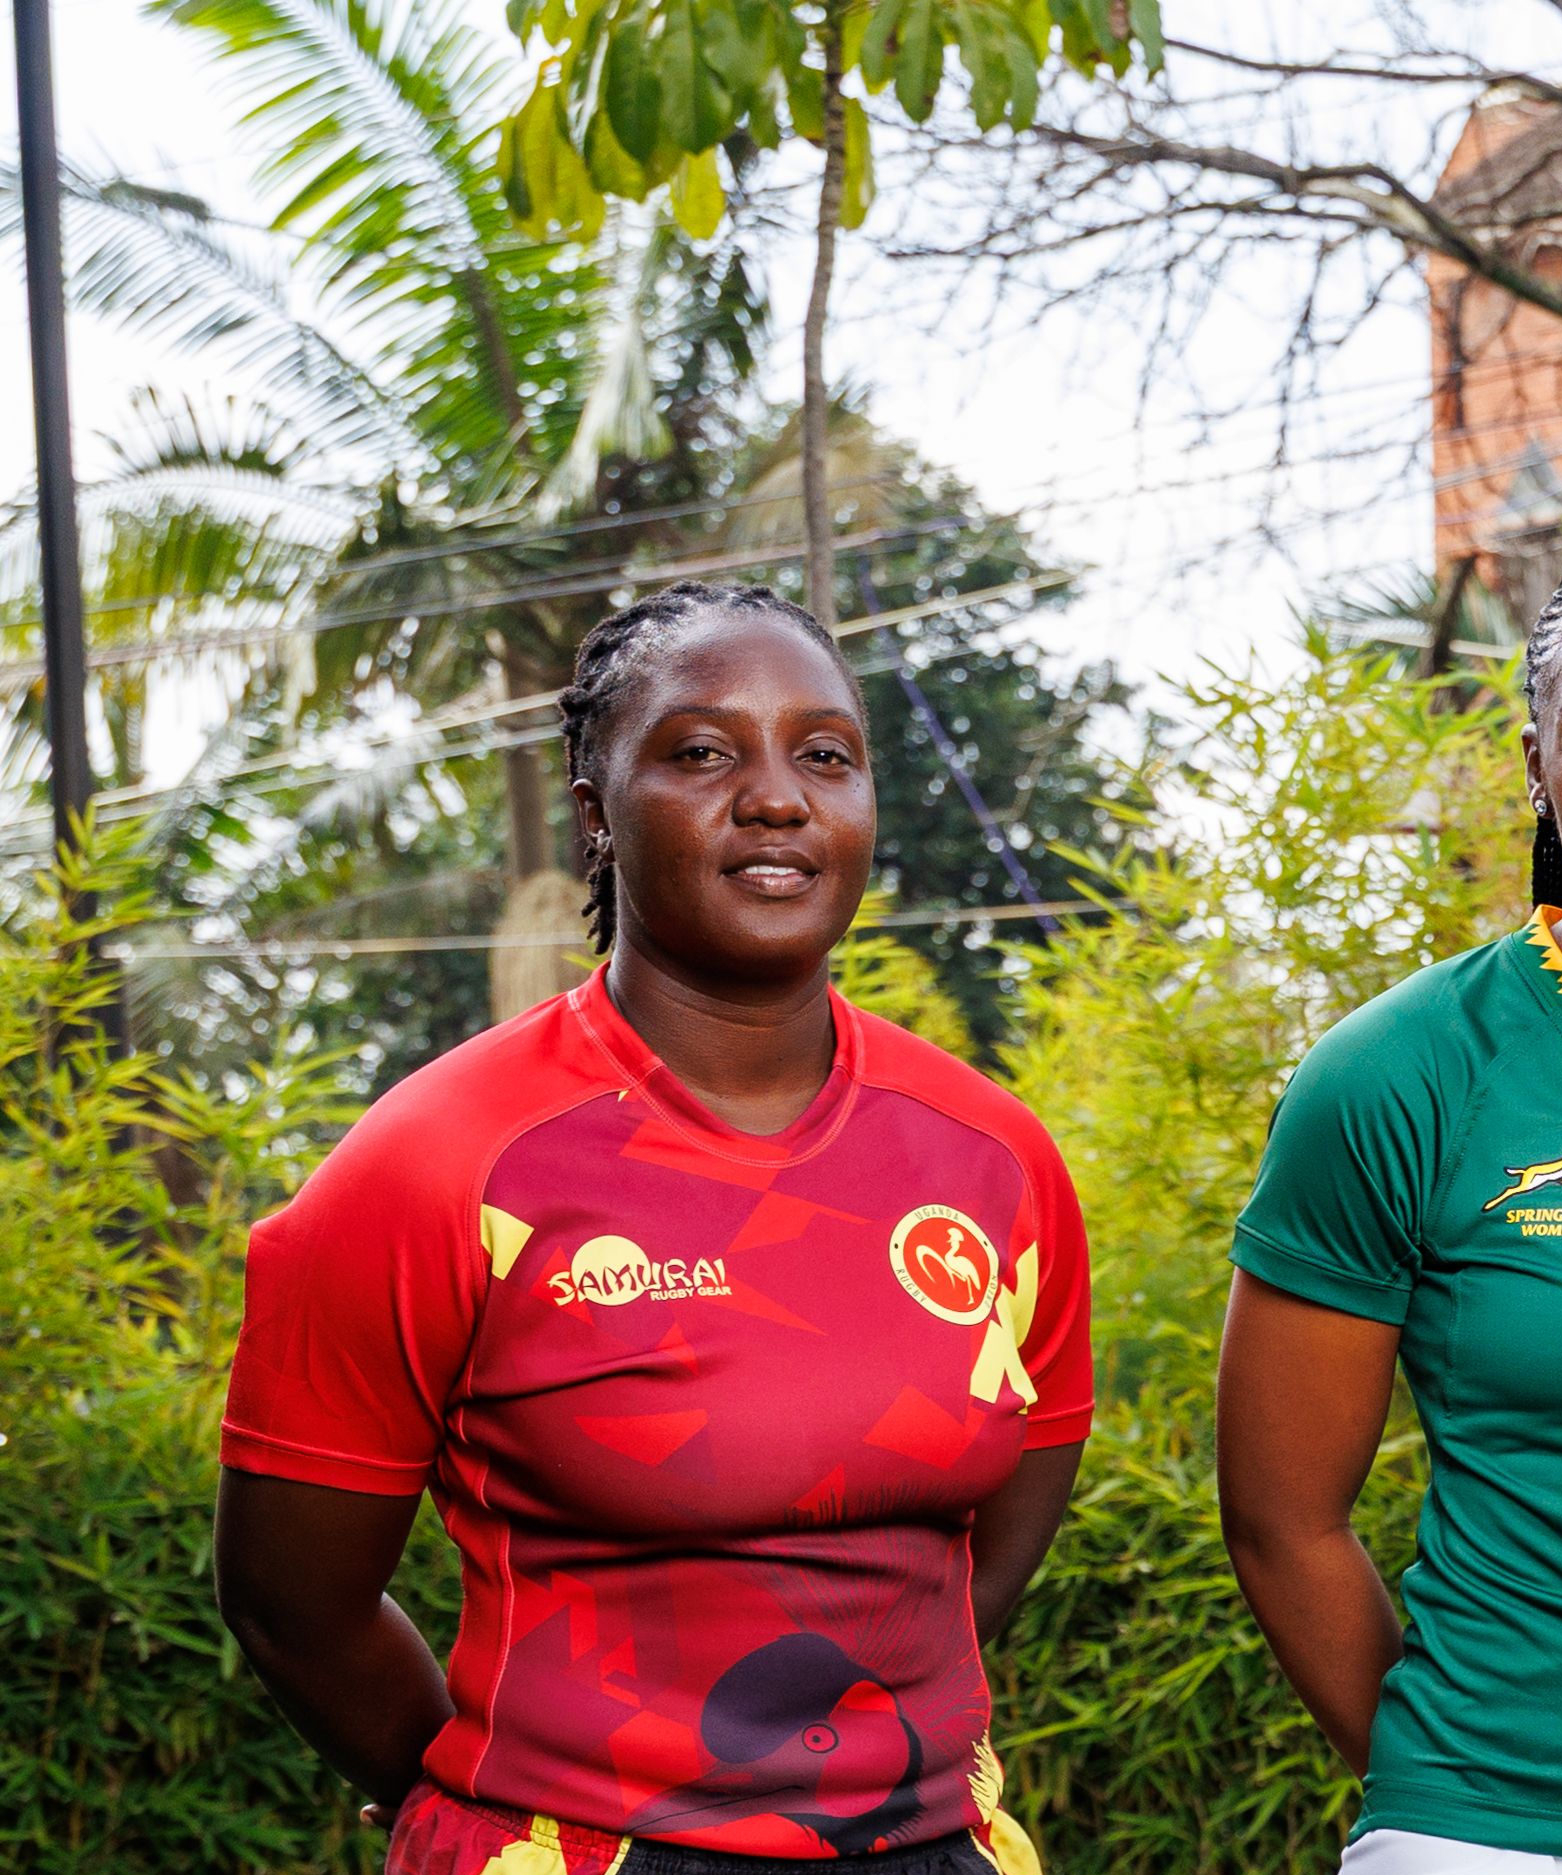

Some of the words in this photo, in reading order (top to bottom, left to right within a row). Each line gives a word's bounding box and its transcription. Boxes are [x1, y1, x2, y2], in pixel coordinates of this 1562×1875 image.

[914, 1207, 959, 1221] UGANDA
[547, 1257, 726, 1307] SAMURAI
[650, 1287, 695, 1301] RUGBY
[697, 1286, 732, 1297] GEAR
[896, 1268, 927, 1303] RUGBY
